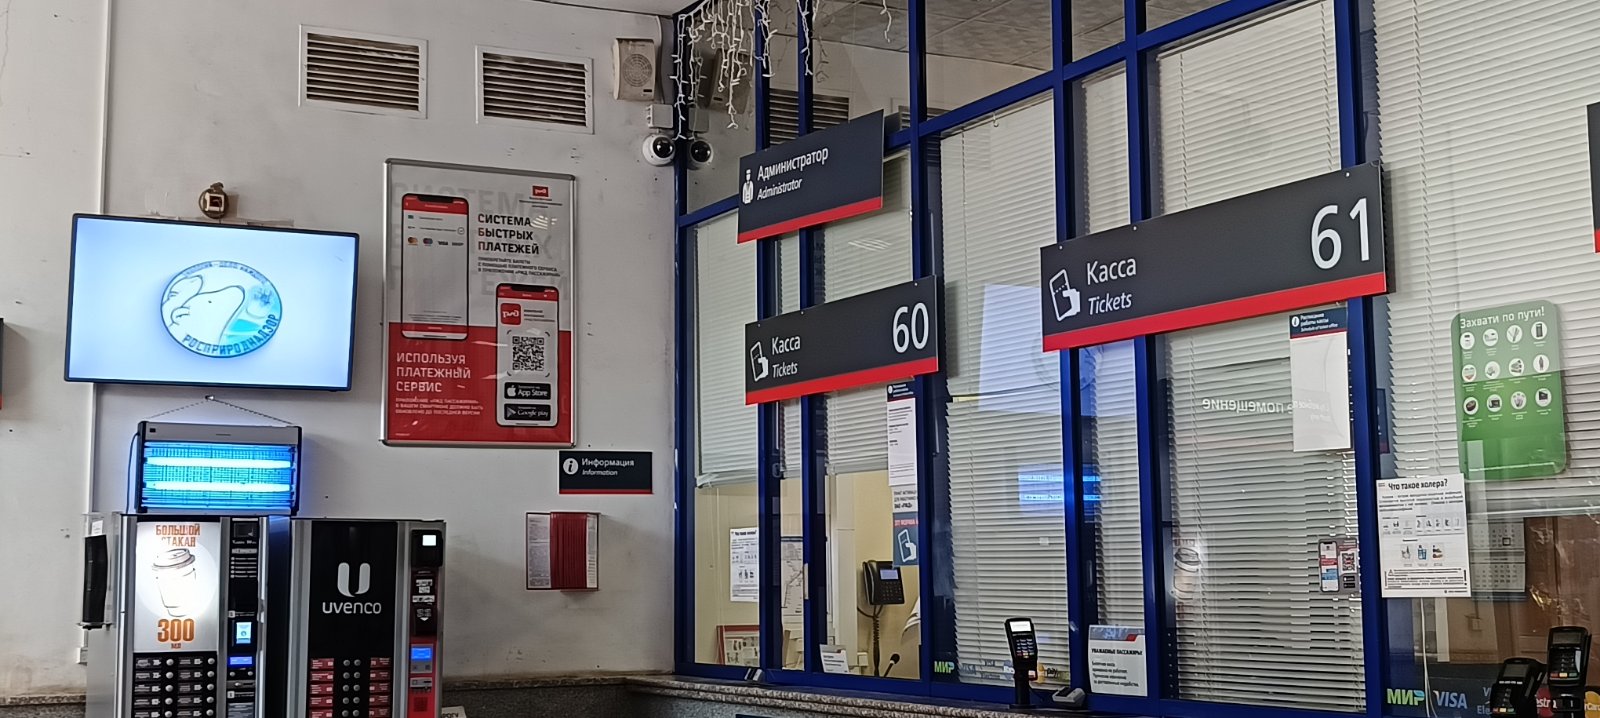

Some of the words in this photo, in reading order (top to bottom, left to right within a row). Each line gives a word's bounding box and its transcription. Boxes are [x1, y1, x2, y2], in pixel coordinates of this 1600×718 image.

[757, 147, 829, 181] Администратор
[757, 177, 803, 200] Administrator
[478, 213, 531, 227] СИСТЕМА
[478, 228, 534, 241] БЫСТРЫХ
[1311, 197, 1370, 270] 61
[478, 241, 540, 255] ПЛАТЕЖЕЙ
[1086, 257, 1137, 285] Касса
[1088, 292, 1132, 316] Tickets
[1460, 315, 1500, 329] Захвати
[1502, 312, 1515, 322] по
[1517, 306, 1545, 322] пути!
[182, 314, 280, 355] РОСПРИРОДНАДЗОР
[893, 302, 929, 354] 60
[771, 335, 801, 355] Касса
[396, 352, 466, 365] ИСПОЛЬЗУЯ
[396, 366, 471, 379] ПЛАТЕЖНЫЙ
[772, 361, 798, 378] Tickets
[396, 381, 442, 393] СЕРВИС
[518, 389, 530, 398] App
[517, 410, 537, 418] Google
[581, 458, 635, 468] Информация
[1388, 482, 1400, 491] Что
[1421, 478, 1448, 489] холера?
[156, 523, 201, 536] БОЛЬШОЙ
[322, 601, 382, 614] uvenco
[158, 618, 195, 642] 300
[934, 661, 955, 673] МИР
[1386, 688, 1426, 706] МИР
[1433, 690, 1468, 709] VISA
